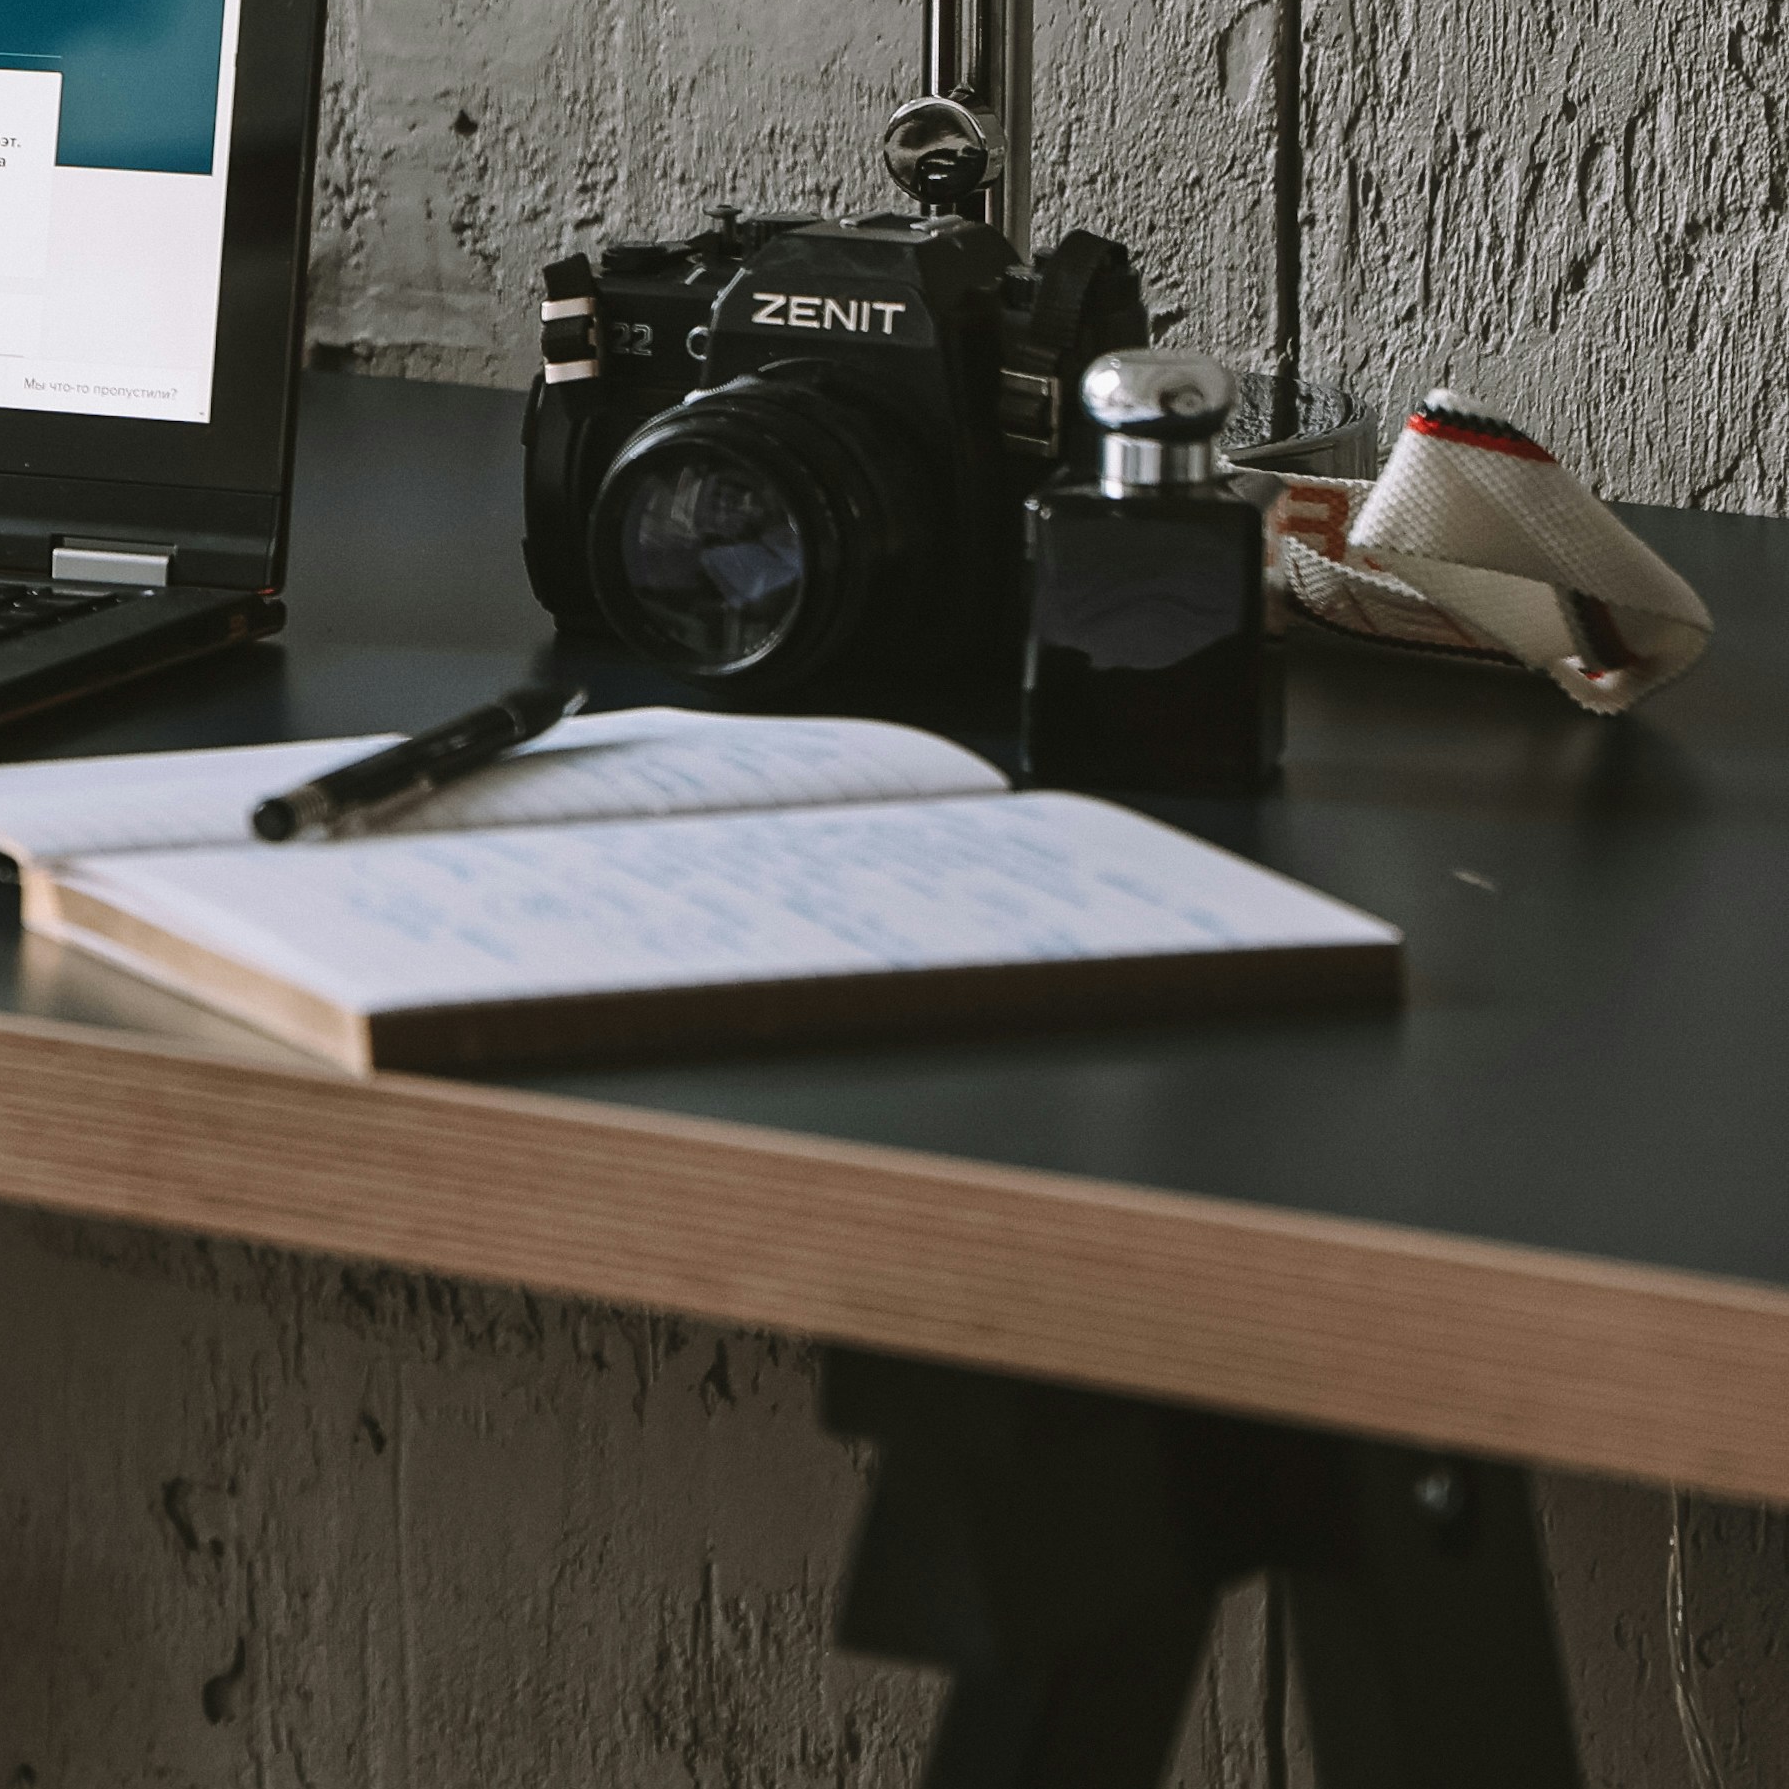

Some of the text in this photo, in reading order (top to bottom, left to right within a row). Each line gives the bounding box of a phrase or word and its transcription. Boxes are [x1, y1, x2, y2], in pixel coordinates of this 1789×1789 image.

[751, 292, 906, 335] ZENIT
[24, 377, 178, 400] Мы что-то пропустили?
